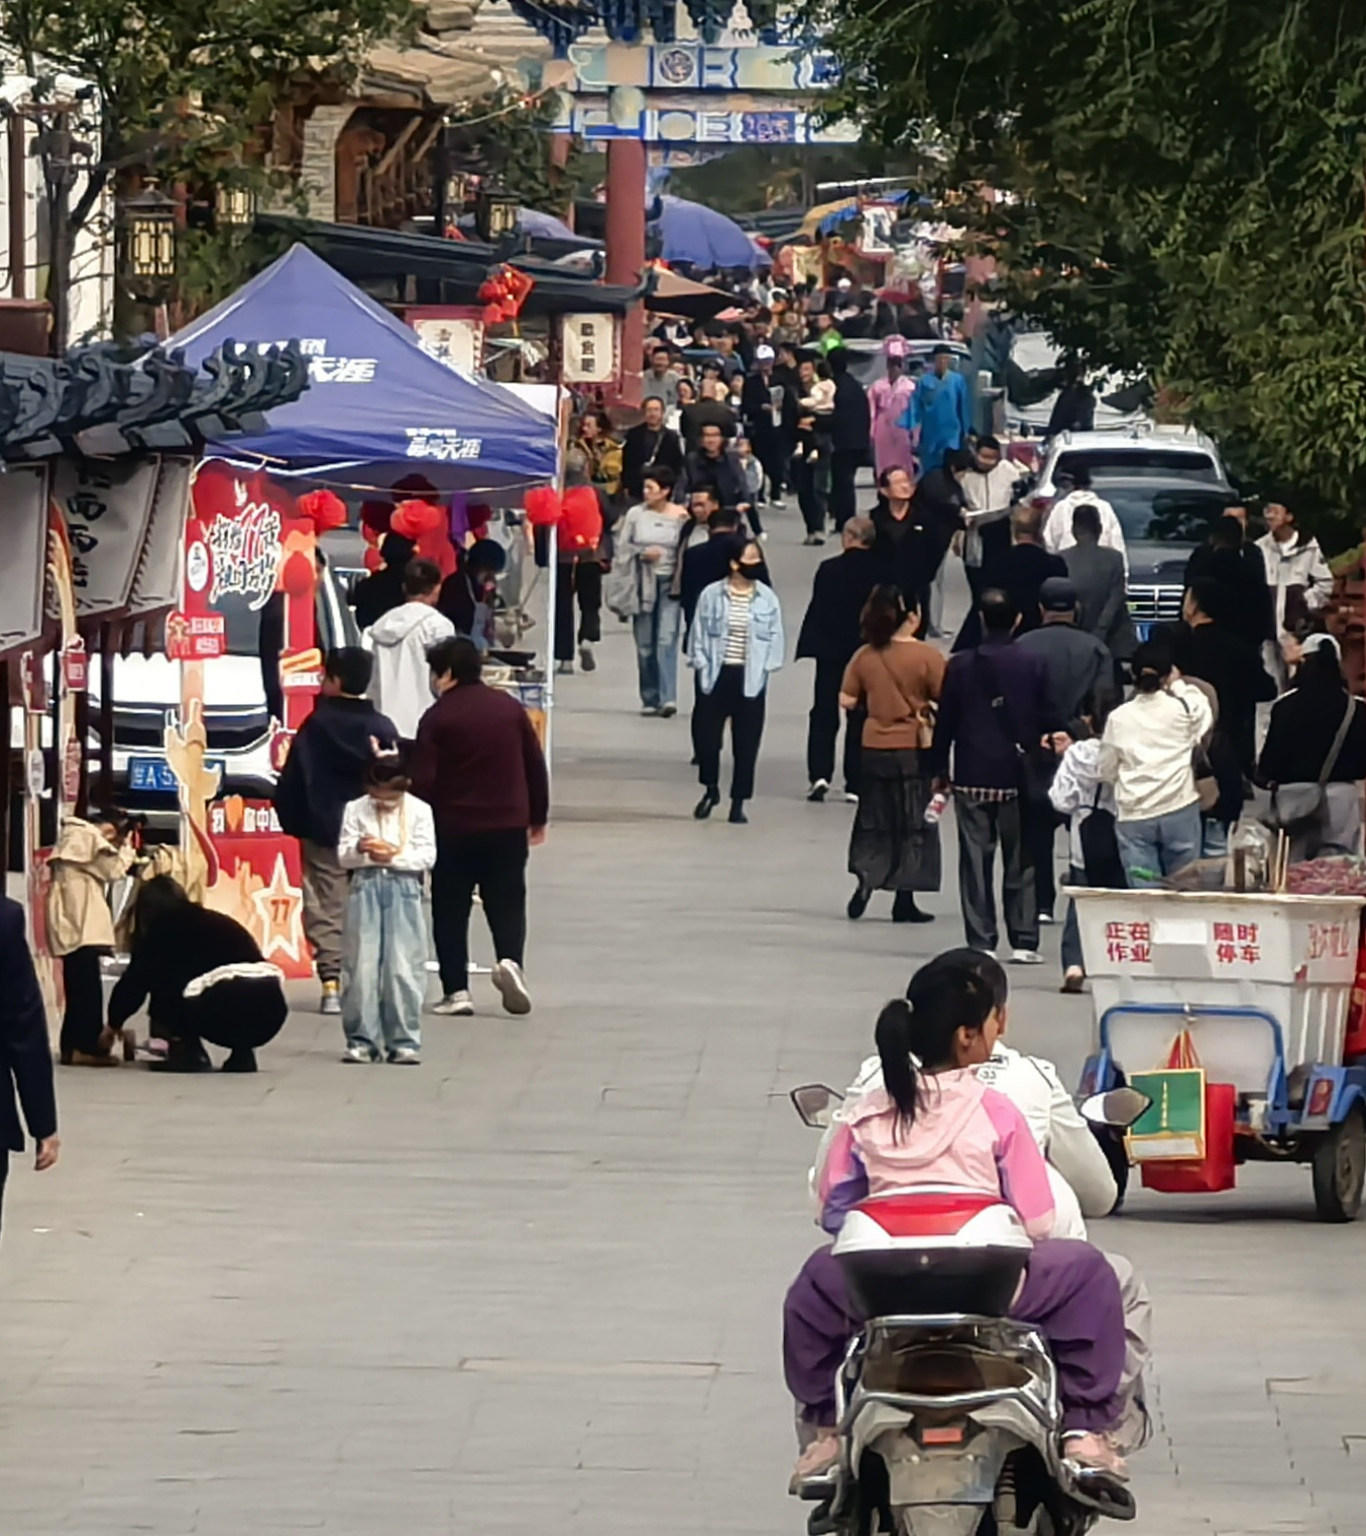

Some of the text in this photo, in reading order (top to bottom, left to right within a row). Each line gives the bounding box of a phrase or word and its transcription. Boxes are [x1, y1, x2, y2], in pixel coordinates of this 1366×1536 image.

[1106, 921, 1151, 941] 正在
[1107, 943, 1152, 963] 作业
[1216, 944, 1261, 964] 停车
